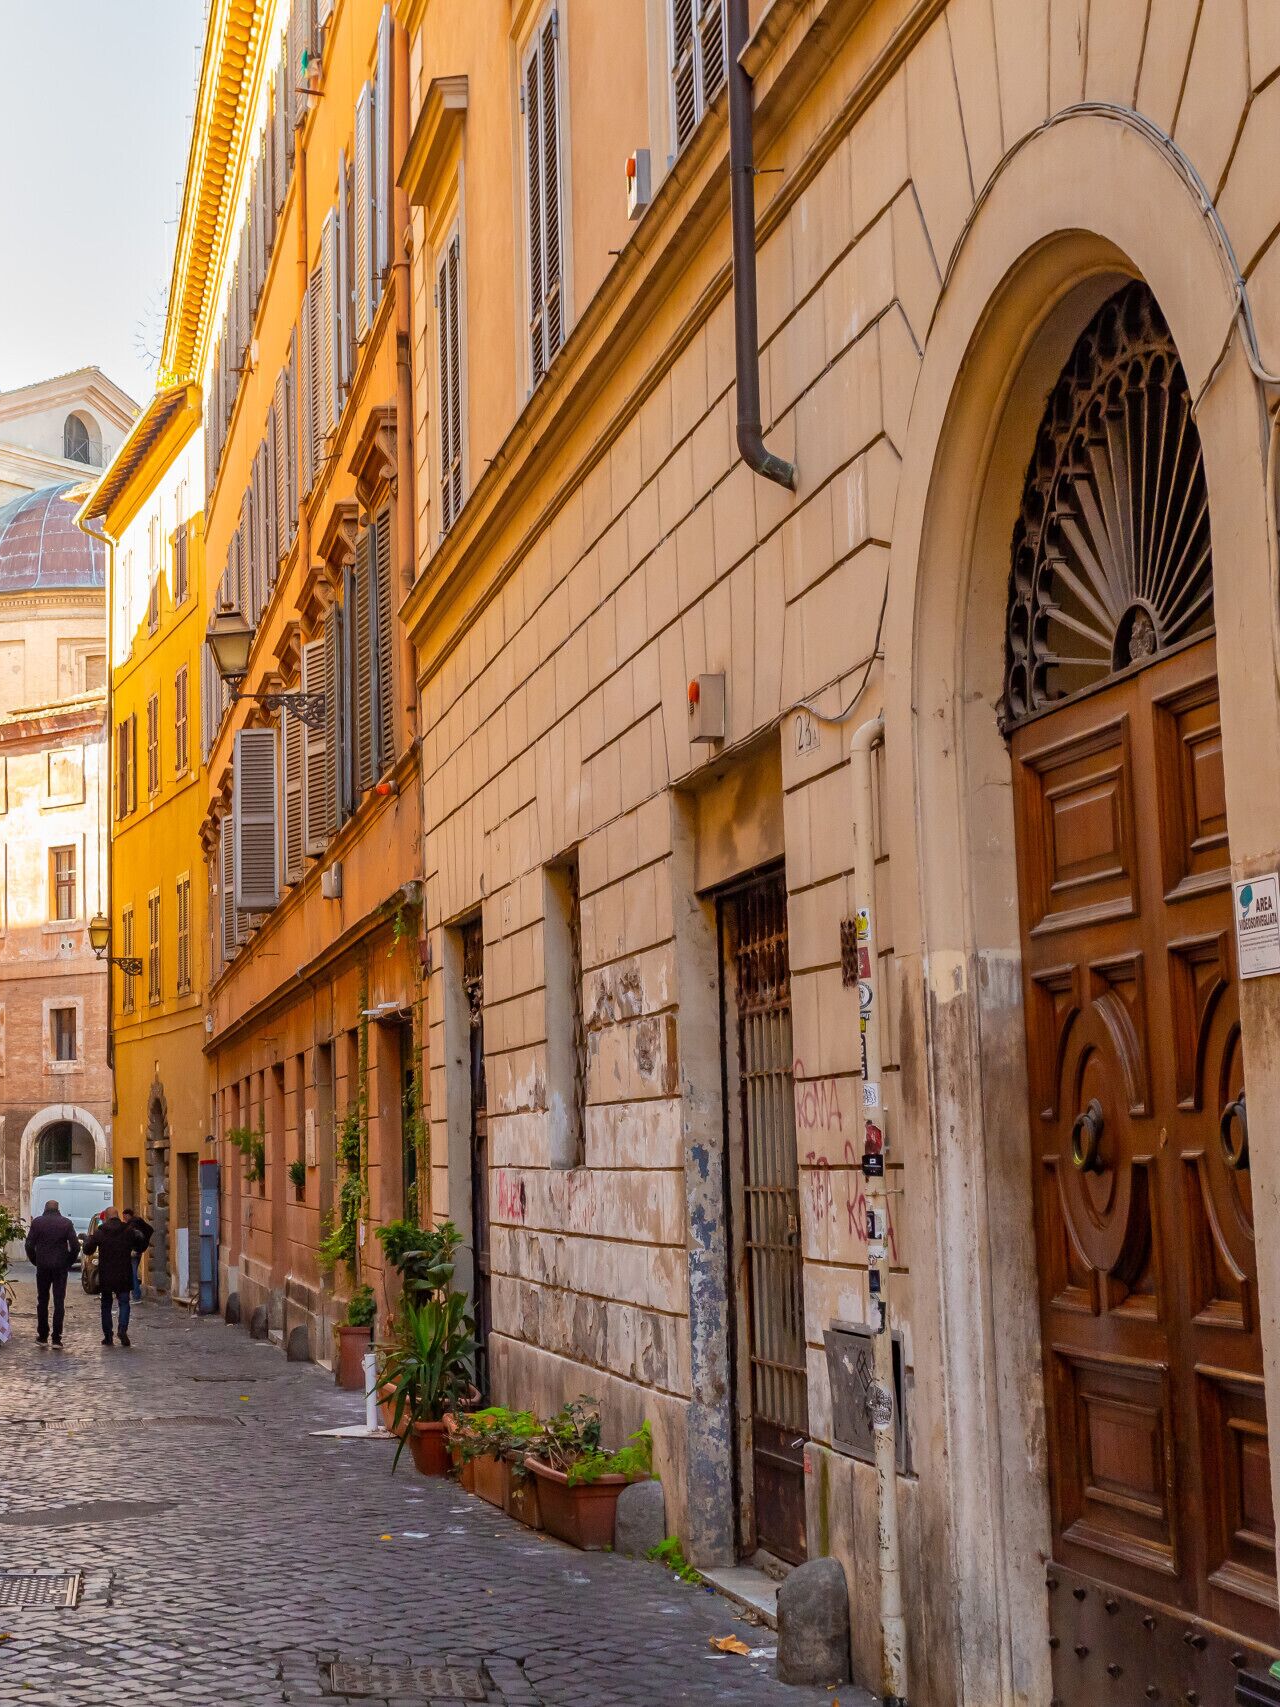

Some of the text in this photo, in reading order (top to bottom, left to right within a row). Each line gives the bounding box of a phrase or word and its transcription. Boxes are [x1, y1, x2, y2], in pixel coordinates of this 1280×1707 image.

[1255, 895, 1273, 913] AREA
[1239, 912, 1278, 931] VIDEOSORVEGLIATA
[794, 1058, 842, 1132] ROMA
